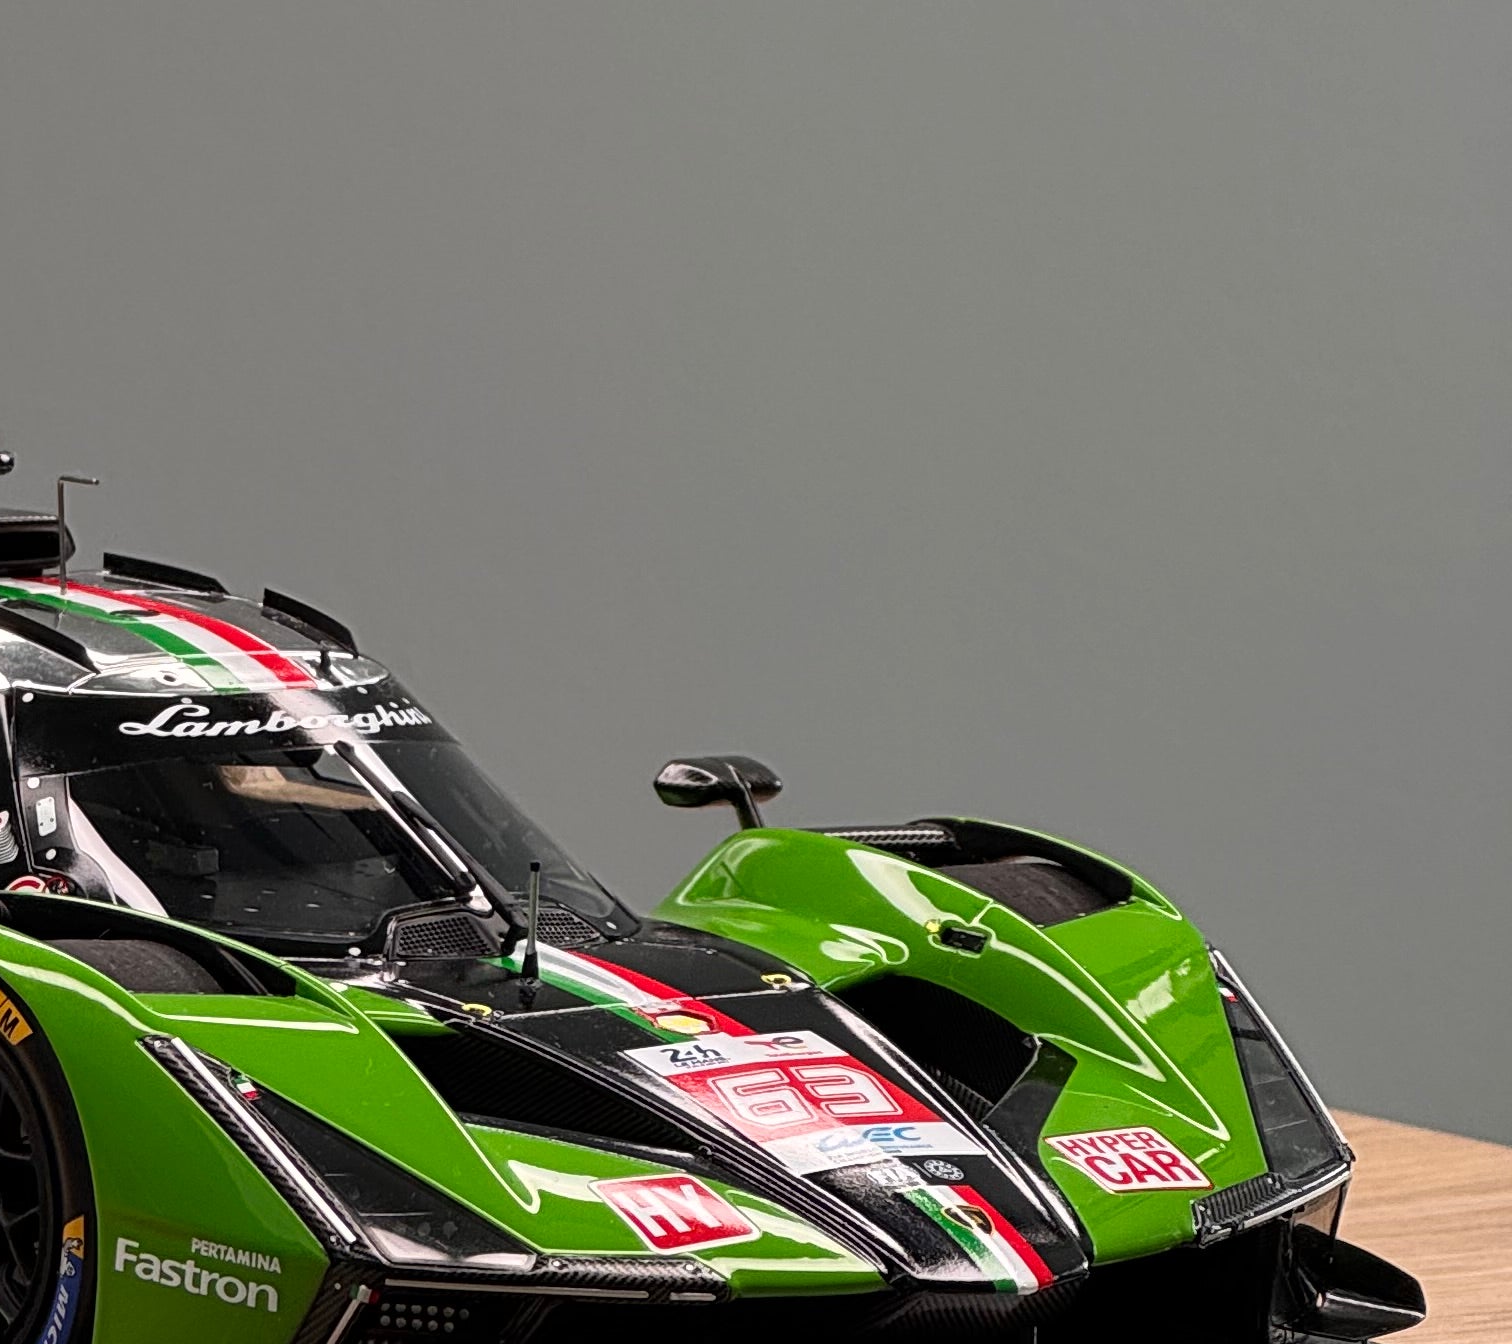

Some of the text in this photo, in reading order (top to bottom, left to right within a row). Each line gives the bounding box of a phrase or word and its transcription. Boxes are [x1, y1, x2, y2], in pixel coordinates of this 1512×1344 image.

[118, 697, 433, 738] Lamborghini
[0, 1007, 21, 1039] M
[659, 1044, 723, 1064] 24h
[706, 1063, 904, 1129] 63
[1056, 1131, 1167, 1156] HYPER
[1084, 1150, 1202, 1185] CAR
[611, 1183, 723, 1238] HY
[191, 1237, 282, 1274] PERTAMINA
[114, 1237, 279, 1313] Fastron
